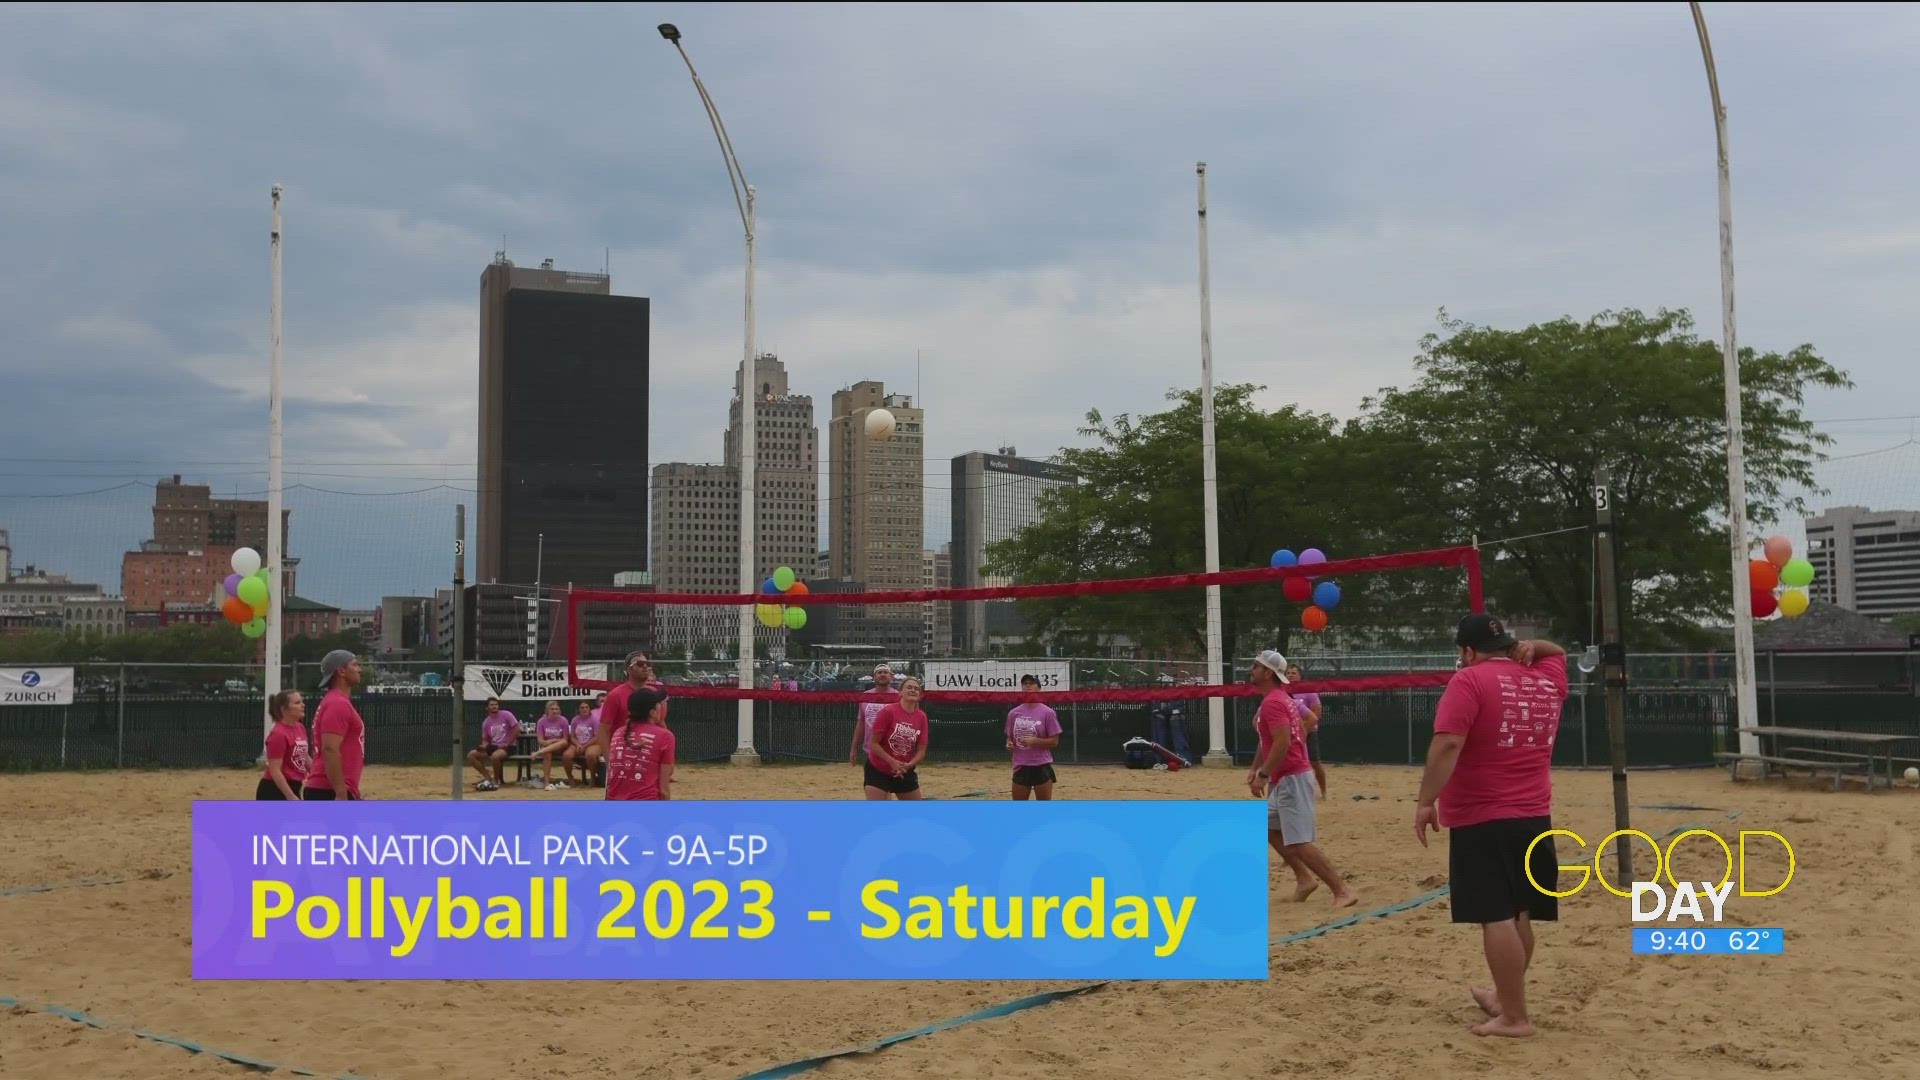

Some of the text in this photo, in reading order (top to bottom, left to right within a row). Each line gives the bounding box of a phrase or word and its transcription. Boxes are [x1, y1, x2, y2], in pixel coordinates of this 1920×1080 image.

[1597, 488, 1607, 509] 3
[521, 669, 565, 682] Black
[935, 674, 974, 688] UAW
[979, 673, 1017, 688] Local
[4, 691, 56, 702] ZURICH
